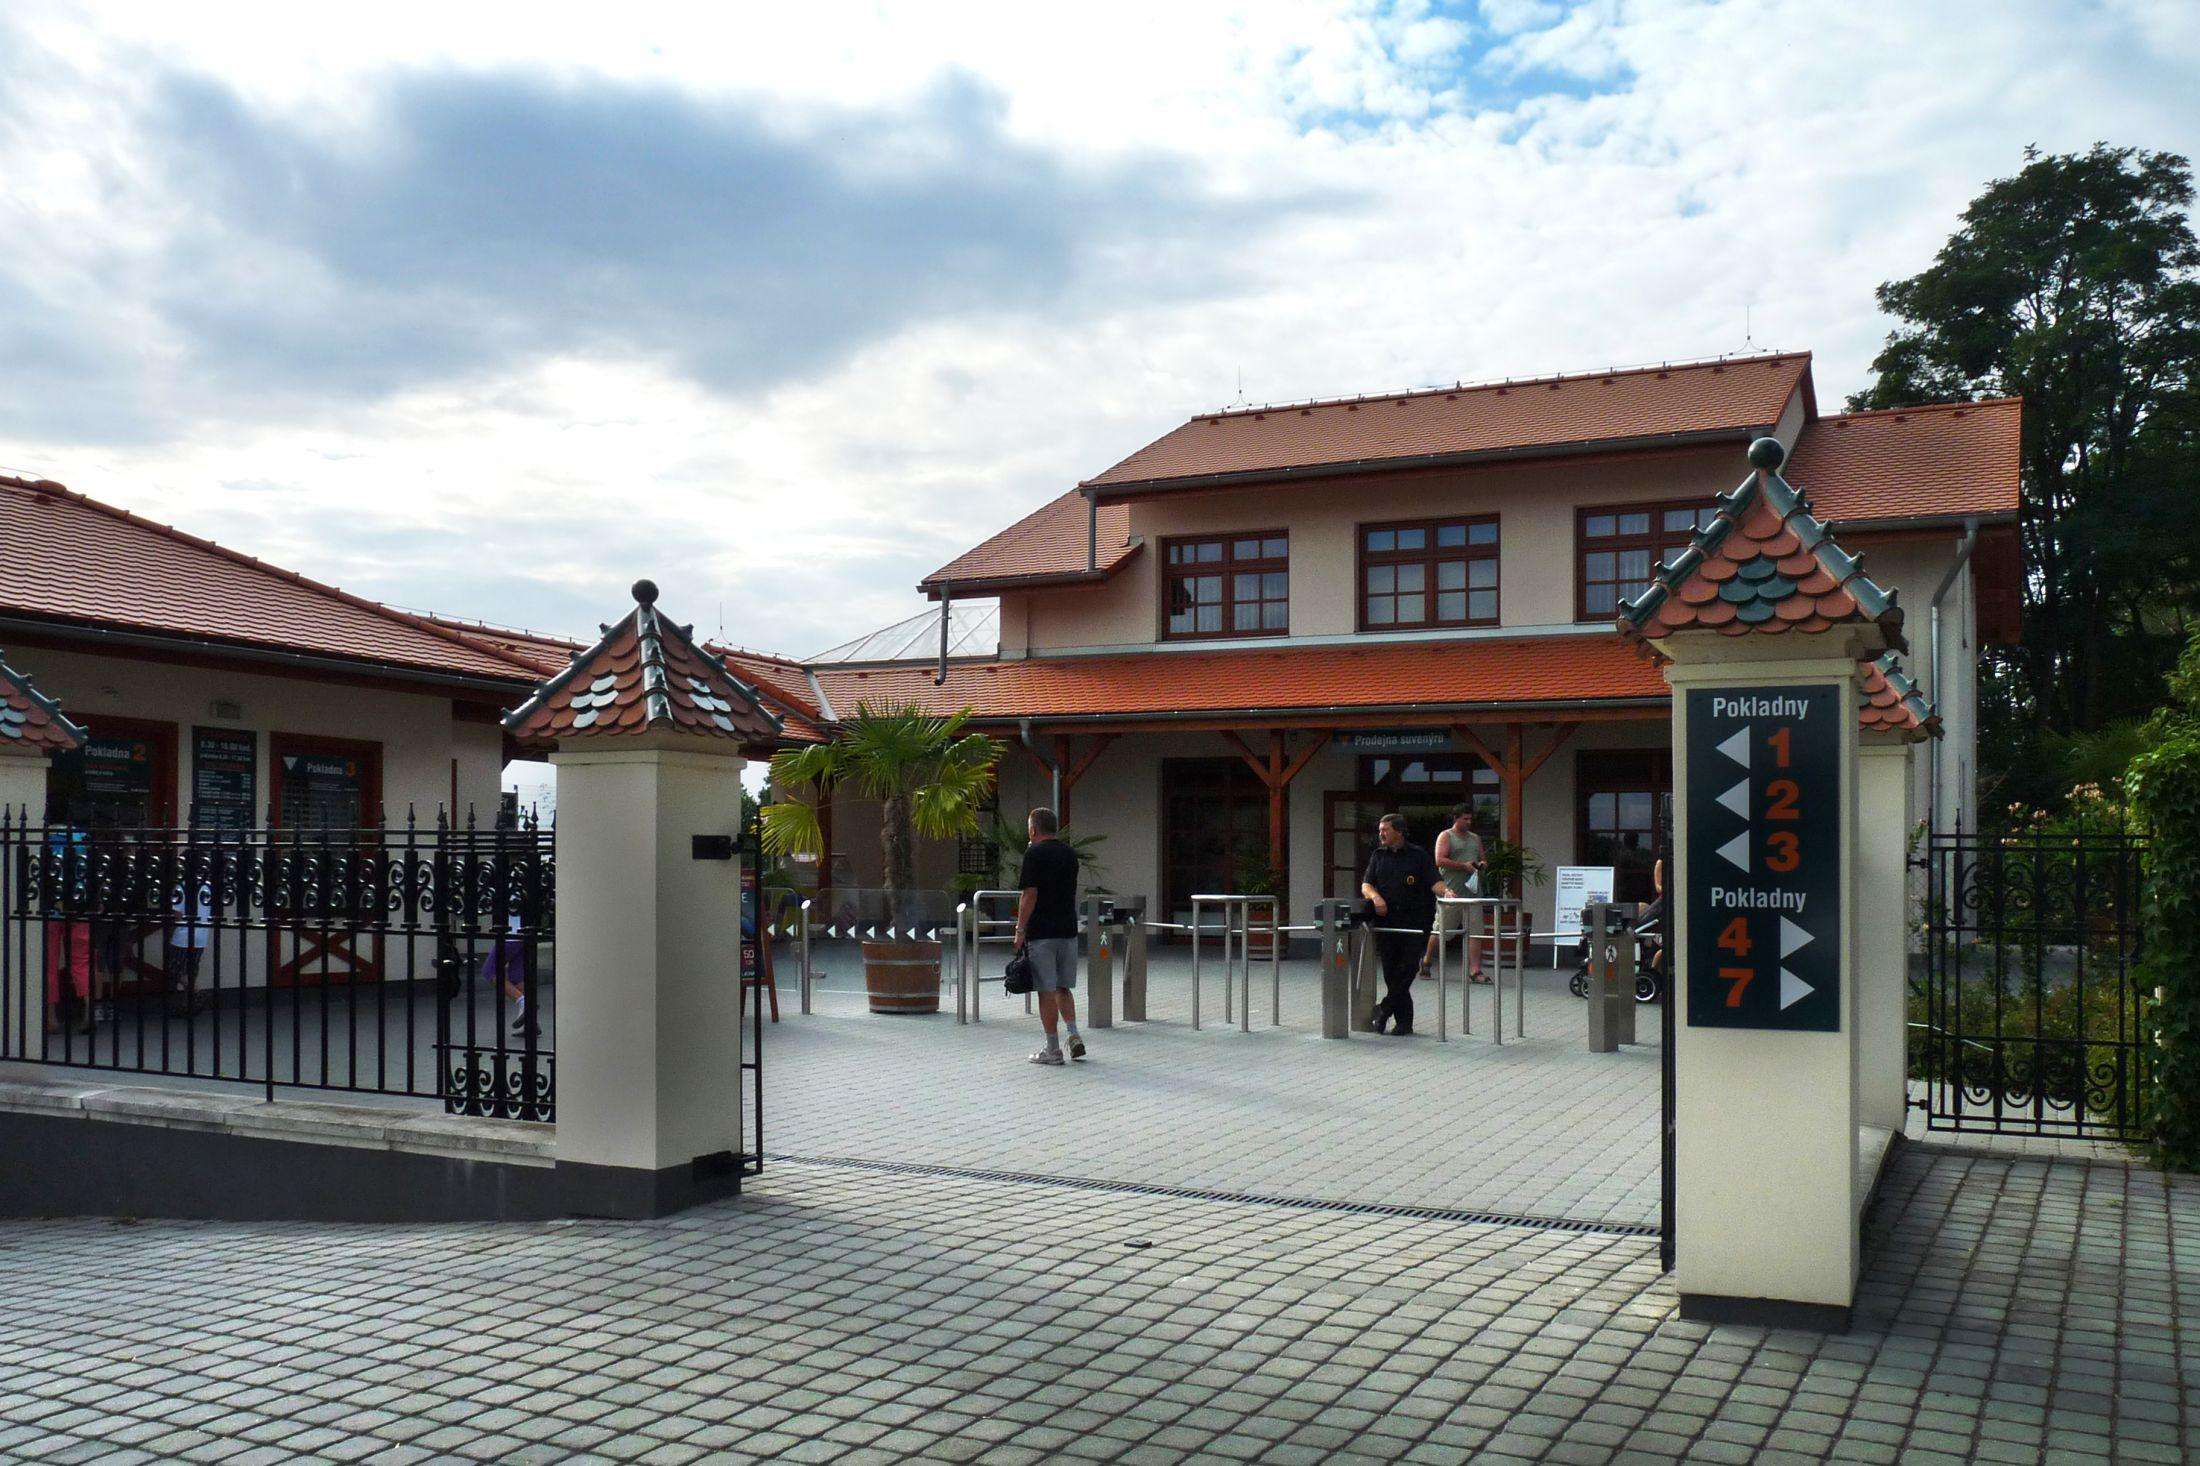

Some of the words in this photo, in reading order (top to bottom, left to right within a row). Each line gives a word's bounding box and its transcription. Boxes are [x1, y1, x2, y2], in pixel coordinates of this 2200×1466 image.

[1713, 695, 1809, 720] Pokladny
[85, 744, 130, 759] Pokladna
[1354, 735, 1398, 748] Prodejna
[1767, 726, 1791, 768] 1
[1764, 779, 1801, 820] 2
[1764, 831, 1801, 872] 3
[1711, 887, 1807, 912] Pokladny
[1717, 916, 1752, 958] 4
[1719, 967, 1755, 1008] 7
